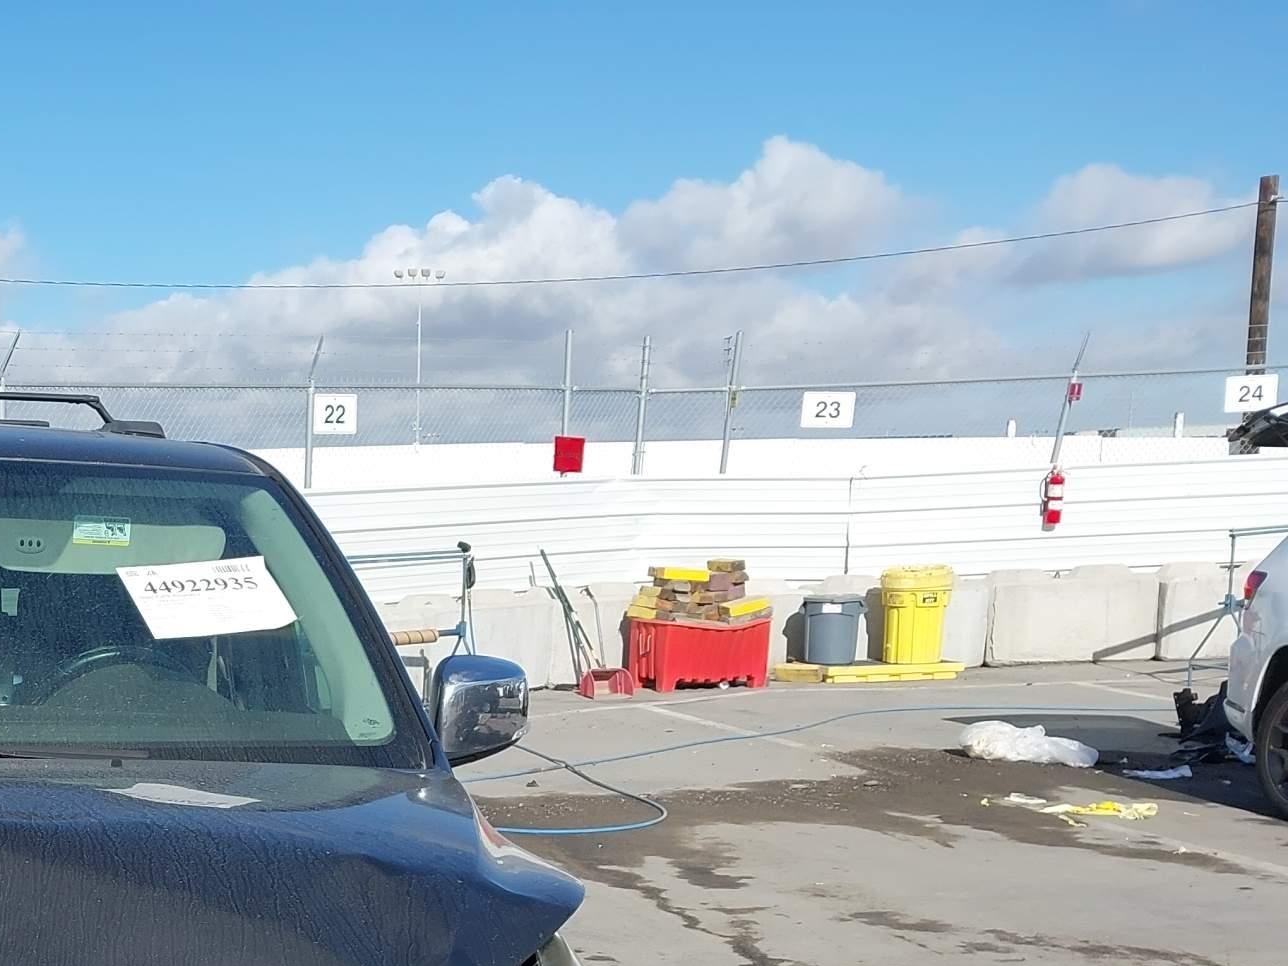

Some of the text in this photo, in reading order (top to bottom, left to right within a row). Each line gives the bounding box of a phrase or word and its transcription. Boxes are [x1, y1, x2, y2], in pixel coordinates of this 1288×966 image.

[1238, 384, 1264, 403] 24
[324, 404, 346, 424] 22
[815, 401, 841, 418] 23
[144, 576, 259, 594] 44922935
